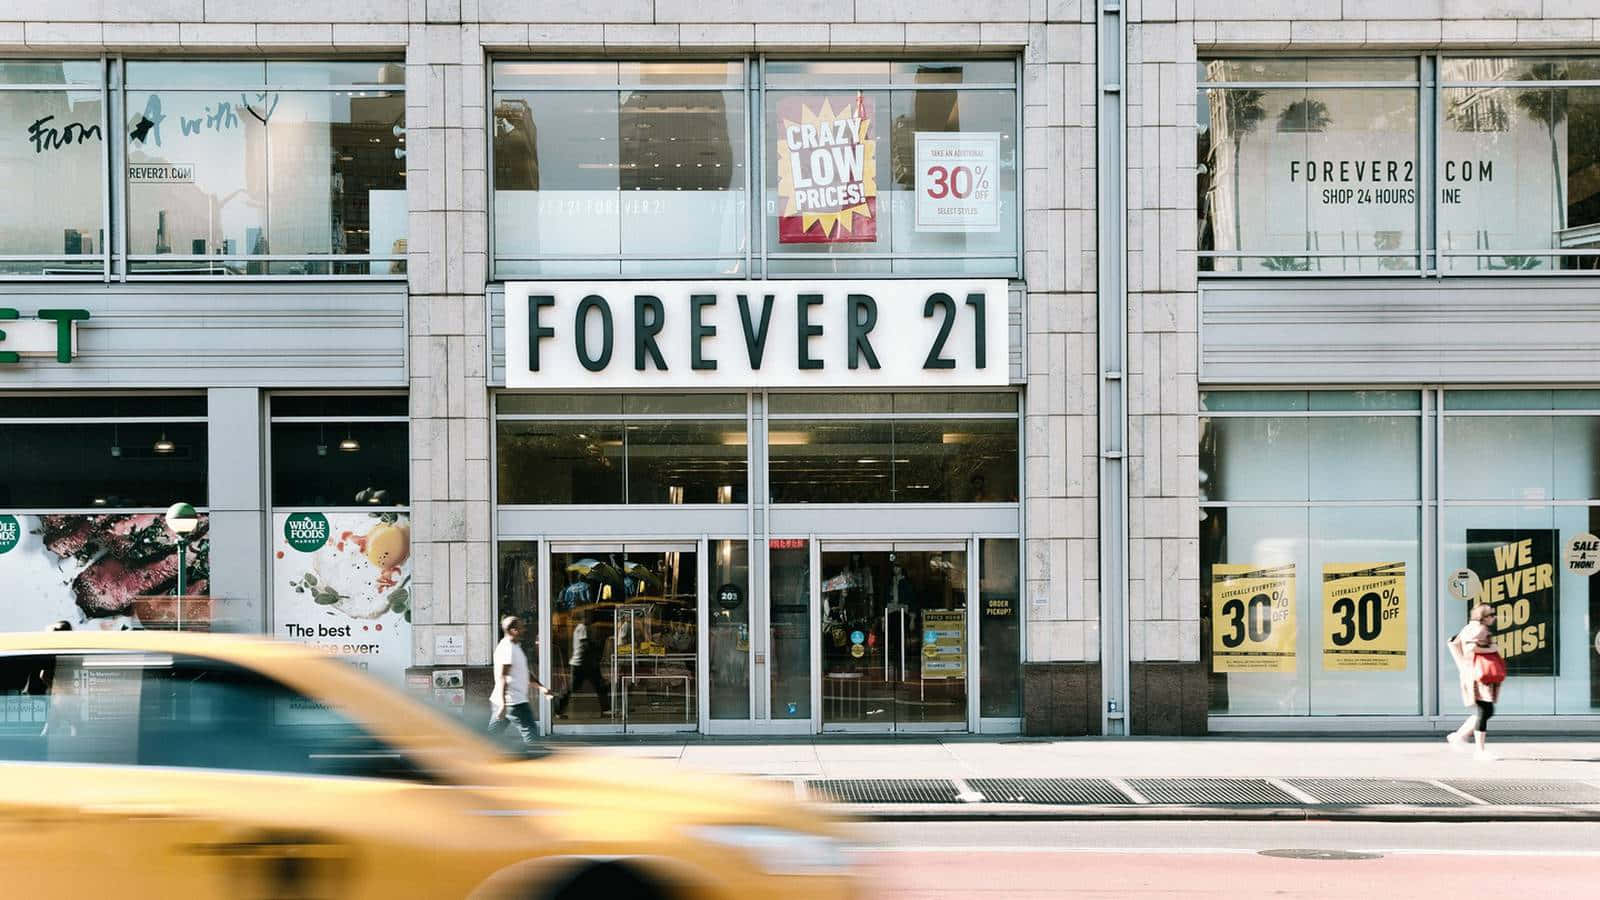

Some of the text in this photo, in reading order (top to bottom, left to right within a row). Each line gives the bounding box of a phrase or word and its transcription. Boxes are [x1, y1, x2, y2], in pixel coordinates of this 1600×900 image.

[27, 115, 103, 153] From
[179, 101, 238, 137] with
[785, 117, 862, 151] CRAZY
[790, 144, 865, 189] LOW
[794, 182, 867, 211] PRICES!
[975, 190, 990, 200] OFF
[1322, 188, 1354, 205] SHOP
[1357, 188, 1372, 205] 24
[1375, 188, 1415, 205] HOURS
[937, 207, 978, 215] SELECT STYLES
[527, 290, 988, 373] FOREVER 21
[288, 519, 326, 531] WHOLE
[290, 530, 326, 539] FOODS
[1572, 540, 1600, 551] SALE
[1493, 538, 1533, 573] WE
[1579, 552, 1588, 561] A
[1568, 560, 1596, 569] THON!
[1331, 578, 1397, 598] LITERALLY EVERYTHING
[1473, 562, 1554, 607] NEVER
[1221, 587, 1251, 599] LITERALLY
[988, 600, 1009, 608] ORDER
[986, 608, 1012, 616] PICKUP?
[1272, 609, 1289, 623] OFF
[1382, 607, 1400, 621] OFF
[1495, 598, 1531, 631] DO
[285, 623, 352, 638] The best
[1490, 623, 1547, 659] HIS!
[342, 643, 380, 655] ever:
